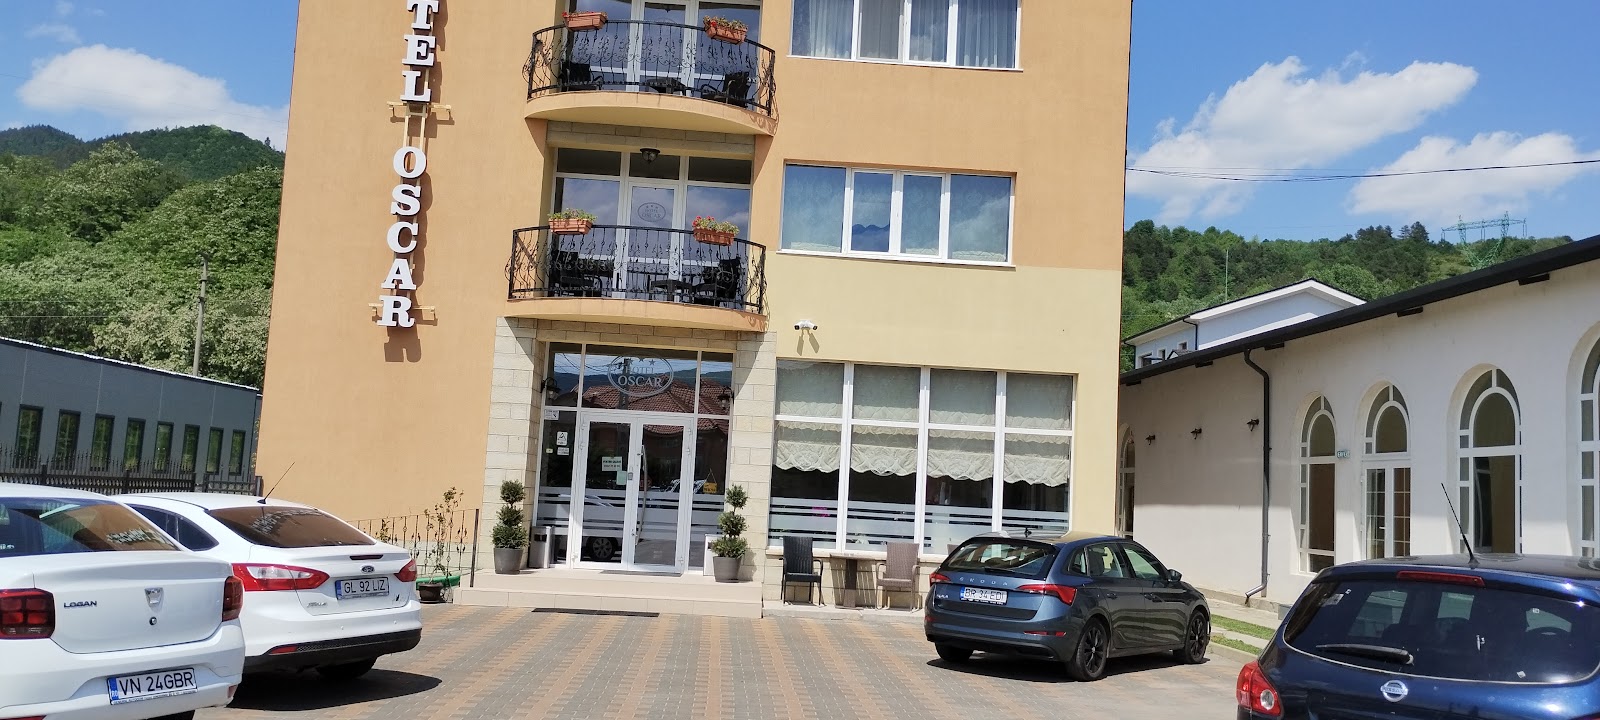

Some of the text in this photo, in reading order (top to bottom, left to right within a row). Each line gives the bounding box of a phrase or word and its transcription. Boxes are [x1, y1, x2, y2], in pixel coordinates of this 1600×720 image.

[377, 146, 427, 327] OSCAR
[625, 366, 654, 374] HOTEL
[617, 375, 662, 388] OSCAR
[343, 579, 386, 594] GL 92 LIZ
[965, 588, 977, 598] BR
[989, 591, 1004, 600] EDI
[63, 600, 98, 609] LOGAN
[119, 677, 142, 696] VN
